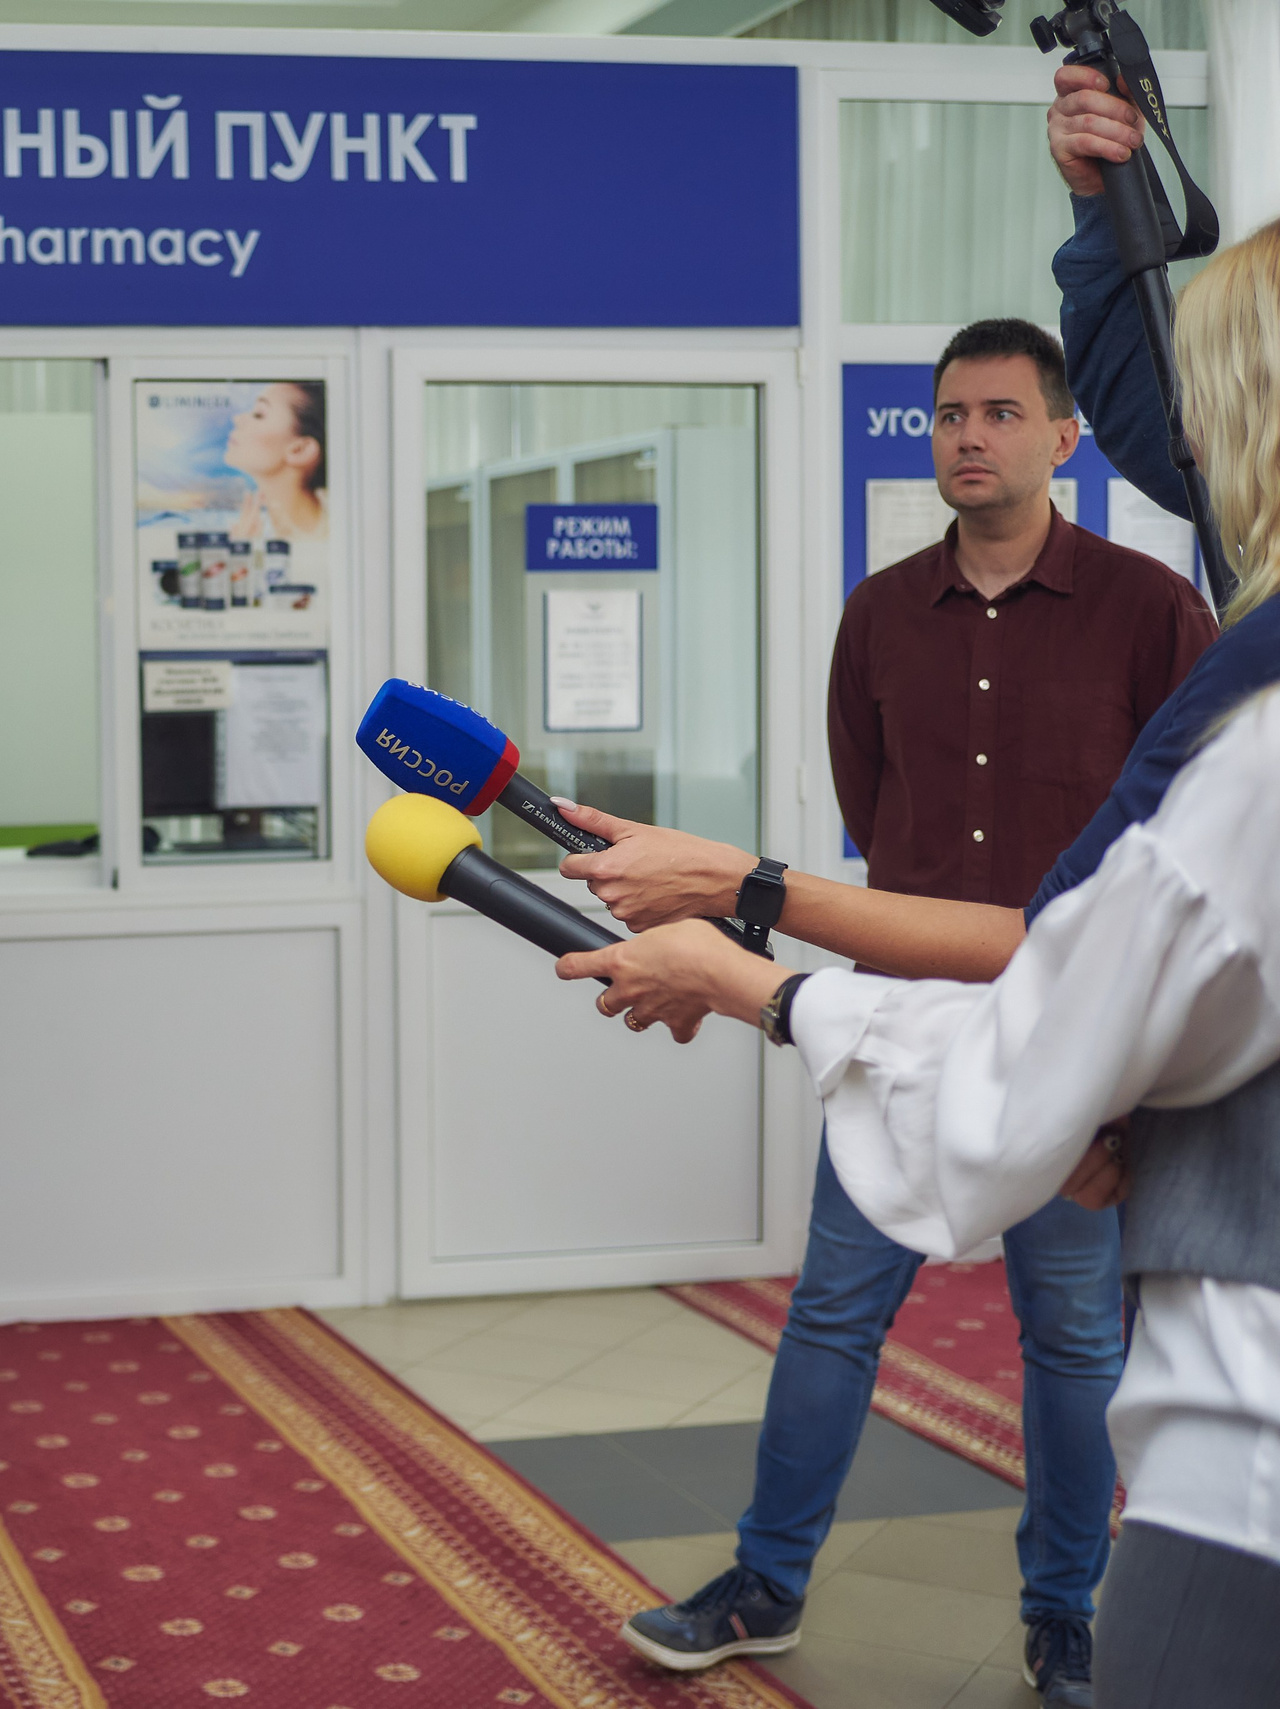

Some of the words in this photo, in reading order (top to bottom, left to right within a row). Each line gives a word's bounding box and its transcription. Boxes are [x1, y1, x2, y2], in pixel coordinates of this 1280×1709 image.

[1140, 78, 1170, 139] SONY
[214, 111, 478, 183] ПУНКТ
[546, 538, 639, 560] РАБОТЫ:
[553, 516, 632, 538] РЕЖИМ
[375, 727, 470, 796] РОССИЯ
[534, 809, 587, 849] SENNHEISER
